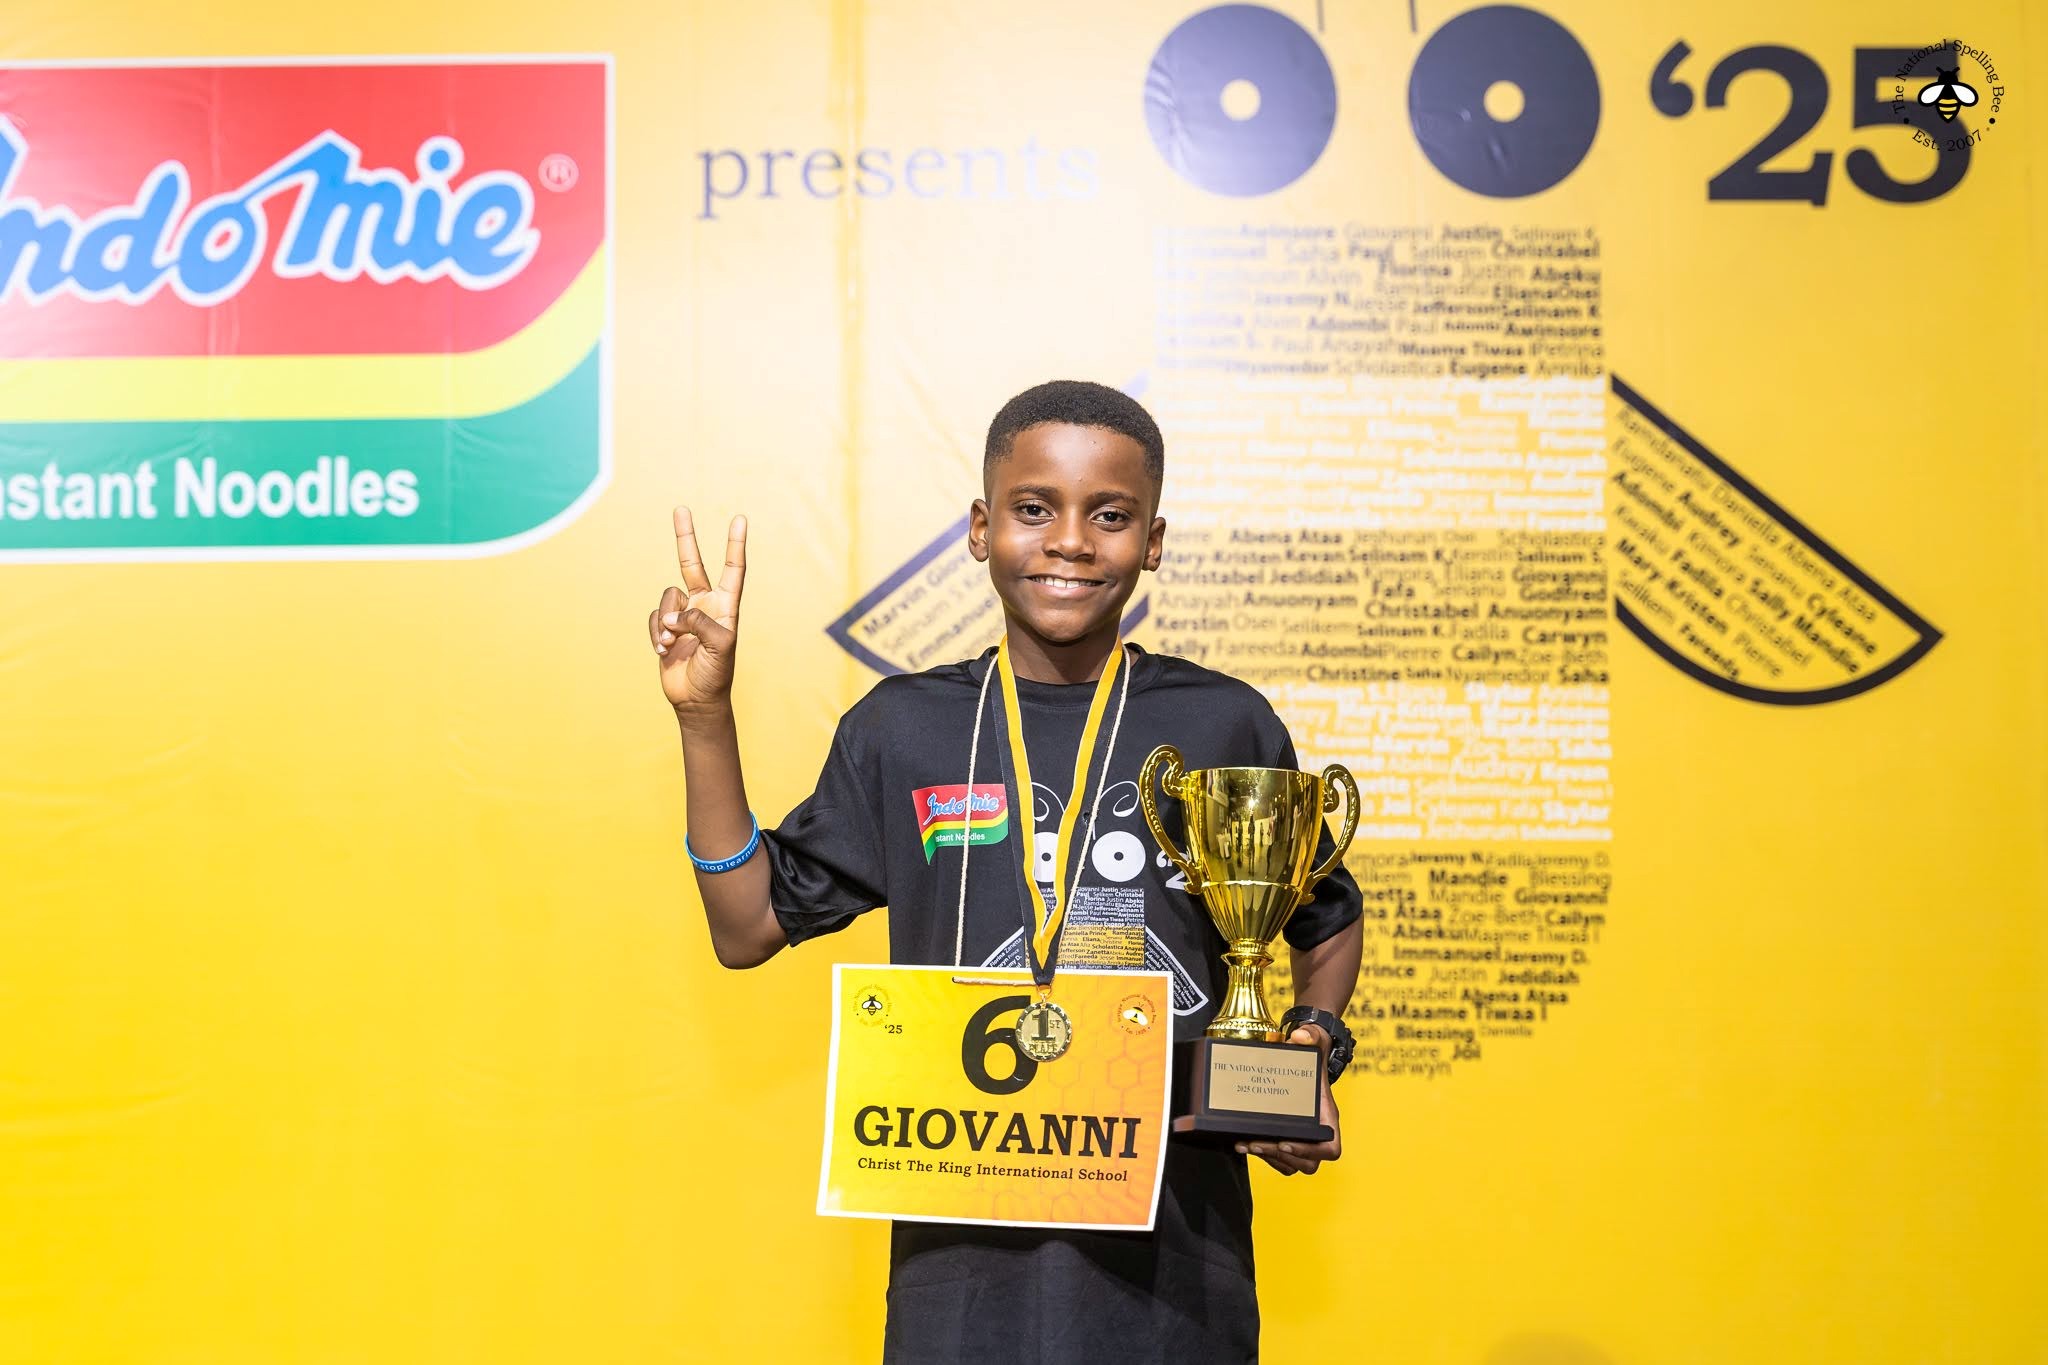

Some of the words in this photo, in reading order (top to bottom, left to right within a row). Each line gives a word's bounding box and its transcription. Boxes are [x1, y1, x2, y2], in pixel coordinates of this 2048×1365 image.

[695, 133, 1100, 221] presents
[174, 455, 420, 519] Noodles
[1230, 529, 1292, 545] Abena
[1299, 529, 1342, 545] Ataa
[1157, 568, 1265, 585] Christabel
[1269, 568, 1359, 586] Jedidiah
[1155, 615, 1230, 632] Kerstin
[1365, 599, 1479, 619] Christabel
[1793, 615, 1860, 674] Mandie
[1307, 664, 1400, 682] Christine
[1558, 664, 1609, 683] Saha
[1429, 869, 1509, 886] Mandie
[1394, 906, 1442, 922] Ataa
[1393, 945, 1502, 962] Immanuel
[1395, 1025, 1475, 1043] Blessing
[960, 993, 1040, 1096] 6
[1214, 1062, 1227, 1071] THE
[1229, 1064, 1265, 1075] NATIONAL
[1265, 1066, 1300, 1077] SPELLING
[1301, 1069, 1314, 1078] BEE
[1250, 1077, 1277, 1085] GHANA
[1236, 1085, 1251, 1093] 2025
[1251, 1086, 1290, 1096] CHAMPION
[853, 1105, 1142, 1160] GIOVANNI
[857, 1156, 902, 1172] Christ
[906, 1159, 934, 1173] The
[938, 1161, 973, 1178] King
[976, 1163, 1074, 1181] International
[1078, 1168, 1129, 1183] School
